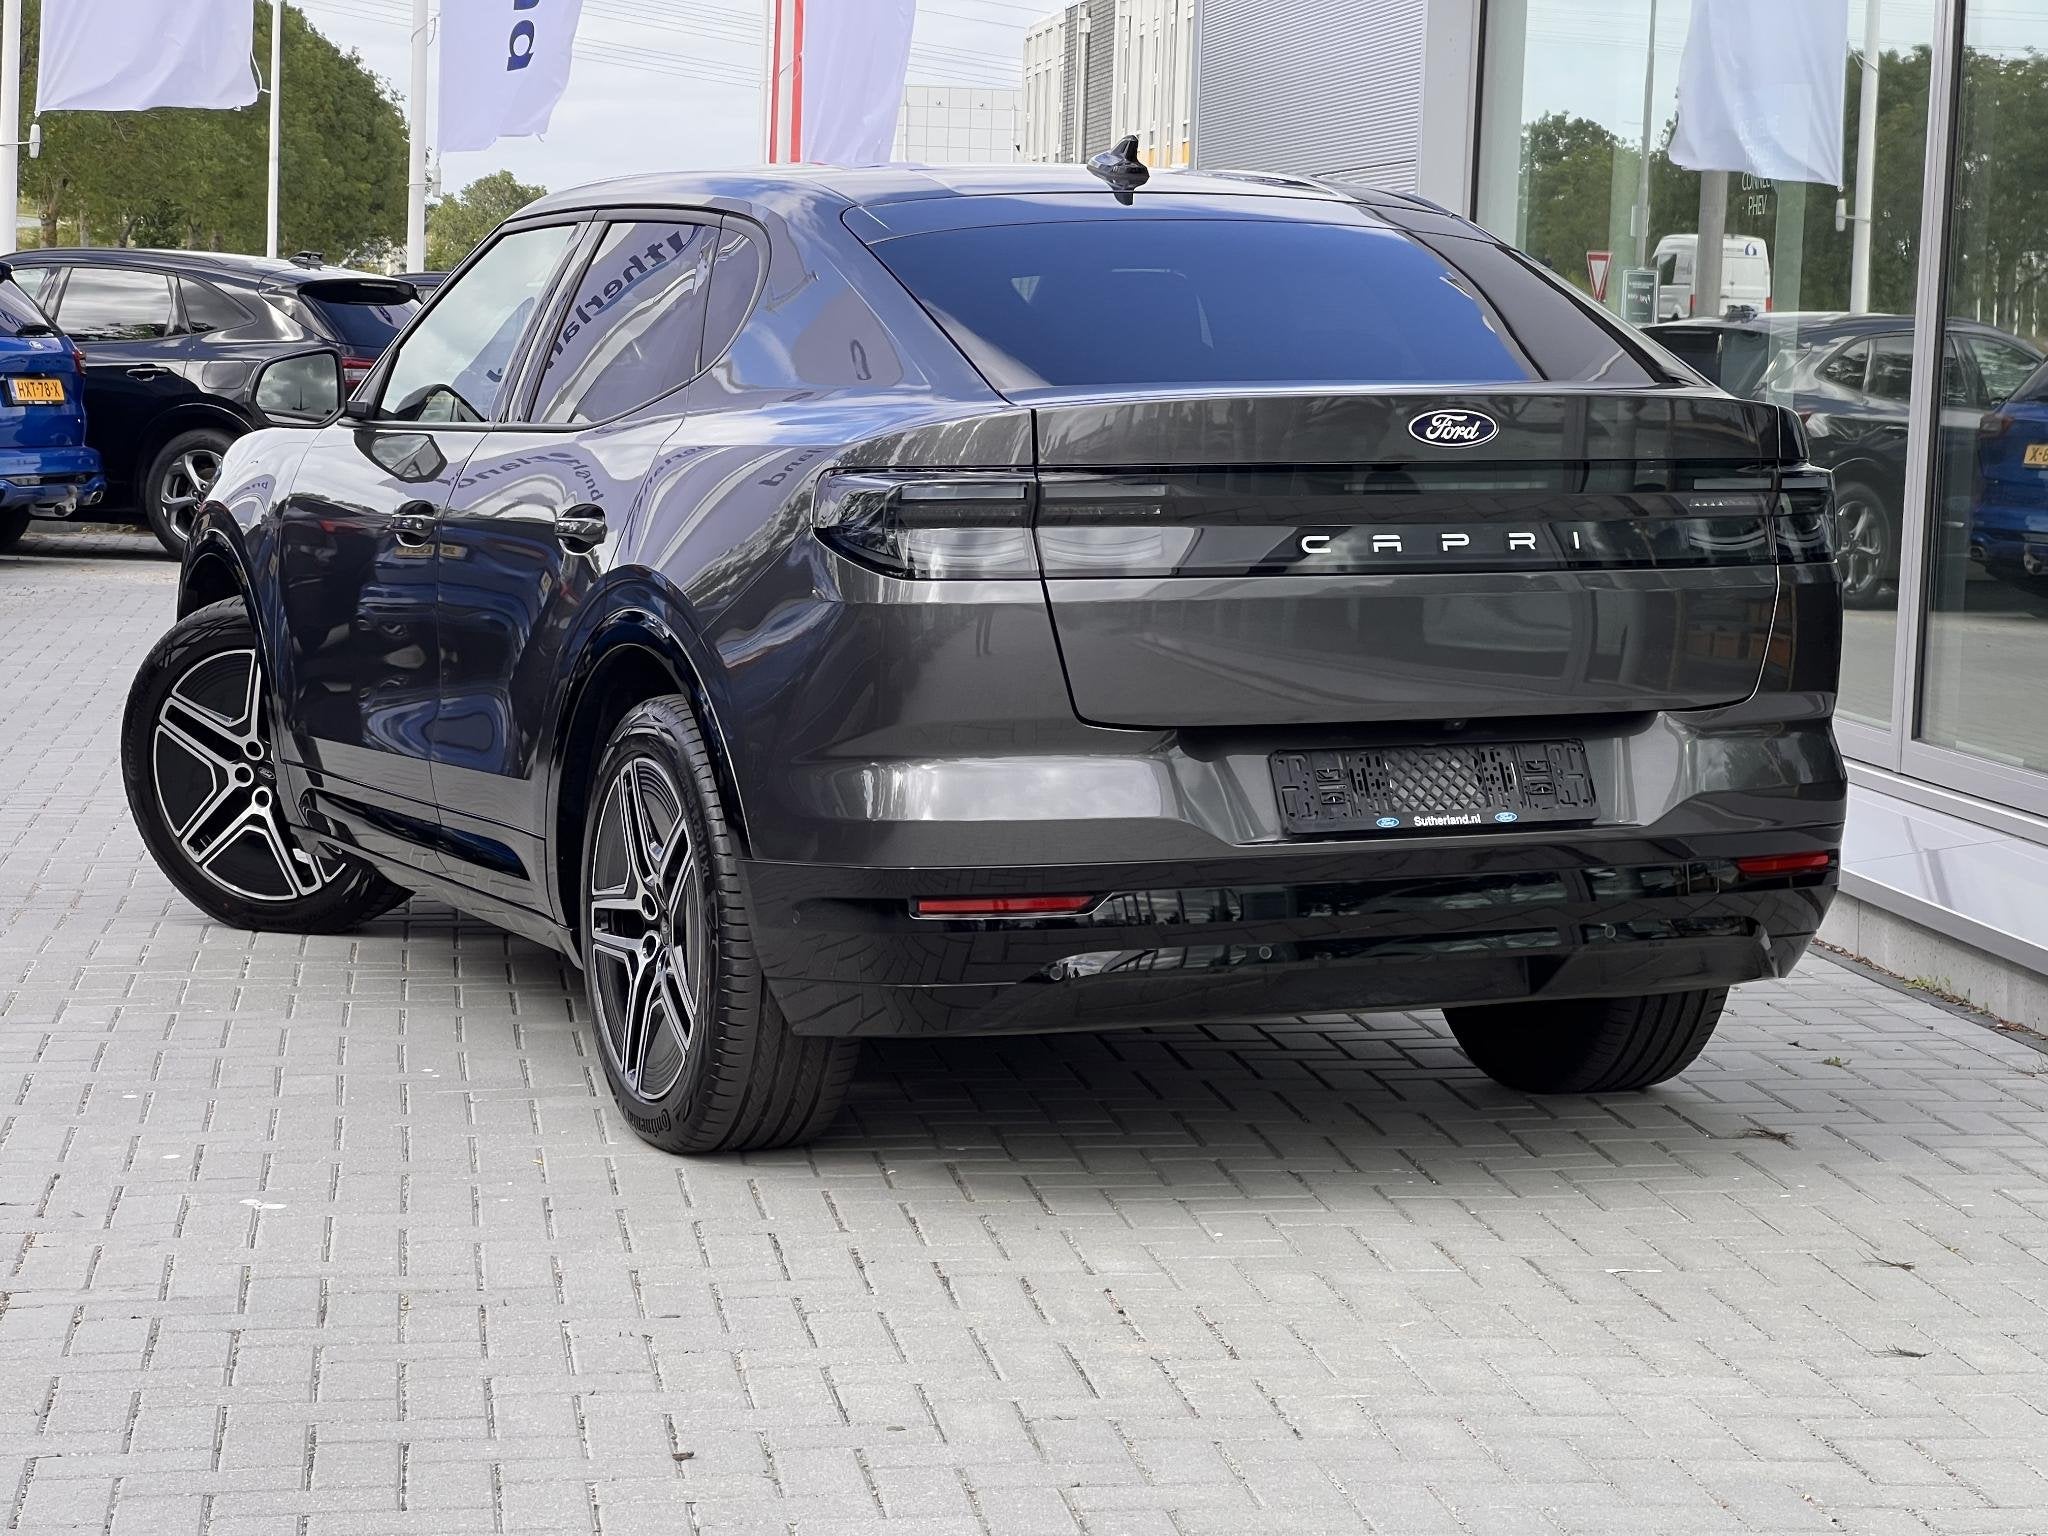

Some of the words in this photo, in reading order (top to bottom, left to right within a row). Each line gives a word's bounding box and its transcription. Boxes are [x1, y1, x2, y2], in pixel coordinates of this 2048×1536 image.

[1748, 194, 1768, 216] PHEV
[16, 381, 61, 398] HXT-78-X
[1425, 413, 1481, 441] Ford
[1300, 531, 1580, 554] CAPRI
[1413, 813, 1482, 827] Sutherland.nl
